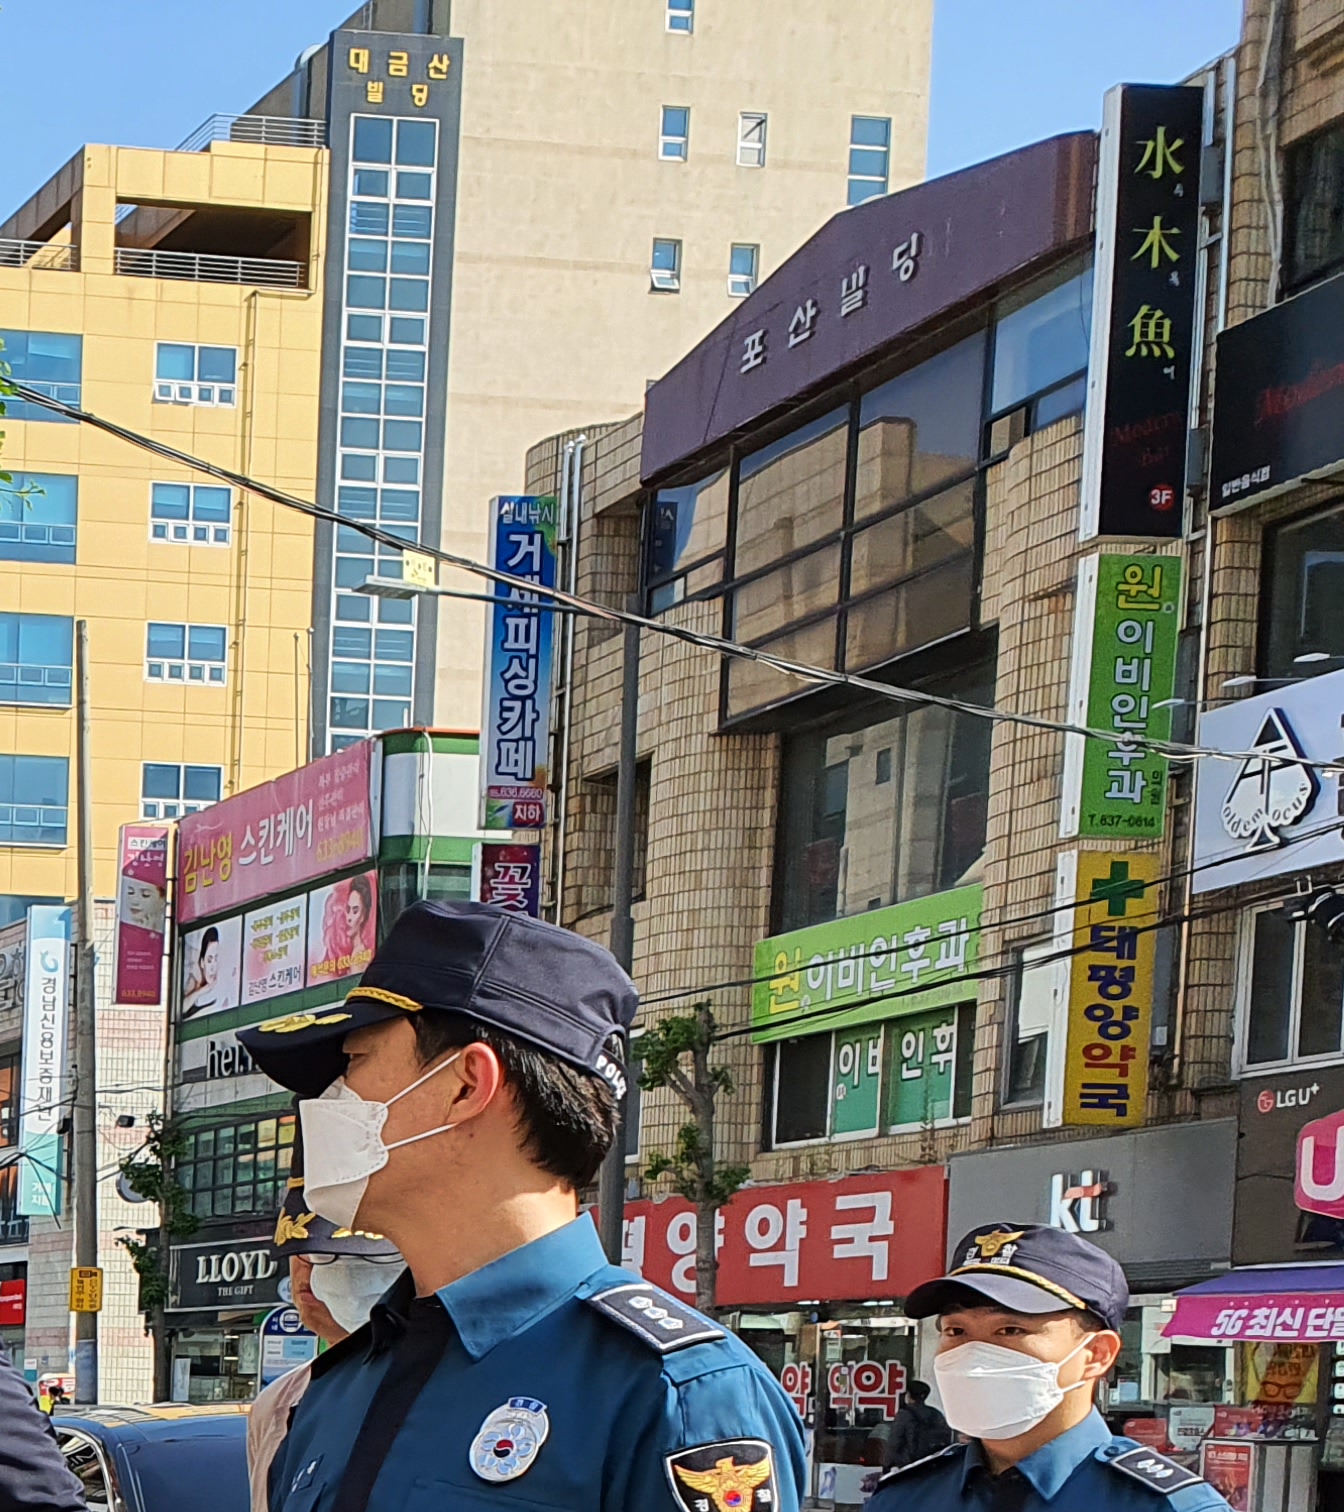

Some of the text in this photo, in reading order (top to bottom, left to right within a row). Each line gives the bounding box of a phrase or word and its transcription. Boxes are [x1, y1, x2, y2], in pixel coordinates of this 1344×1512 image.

[366, 81, 430, 108] 빌딩
[1124, 125, 1186, 360] 水木魚
[739, 230, 924, 376] 포산빌딩
[1150, 489, 1173, 505] 3F
[514, 804, 541, 821] 지하
[184, 831, 233, 894] 김난영
[238, 798, 313, 866] 스킨케어
[1080, 925, 1139, 1117] 태평양약국
[1051, 1170, 1102, 1233] kt
[196, 1249, 277, 1284] LLOYD
[217, 1284, 254, 1296] THE GIFT
[1211, 1309, 1244, 1336] 5G
[1245, 1307, 1304, 1338] 최신
